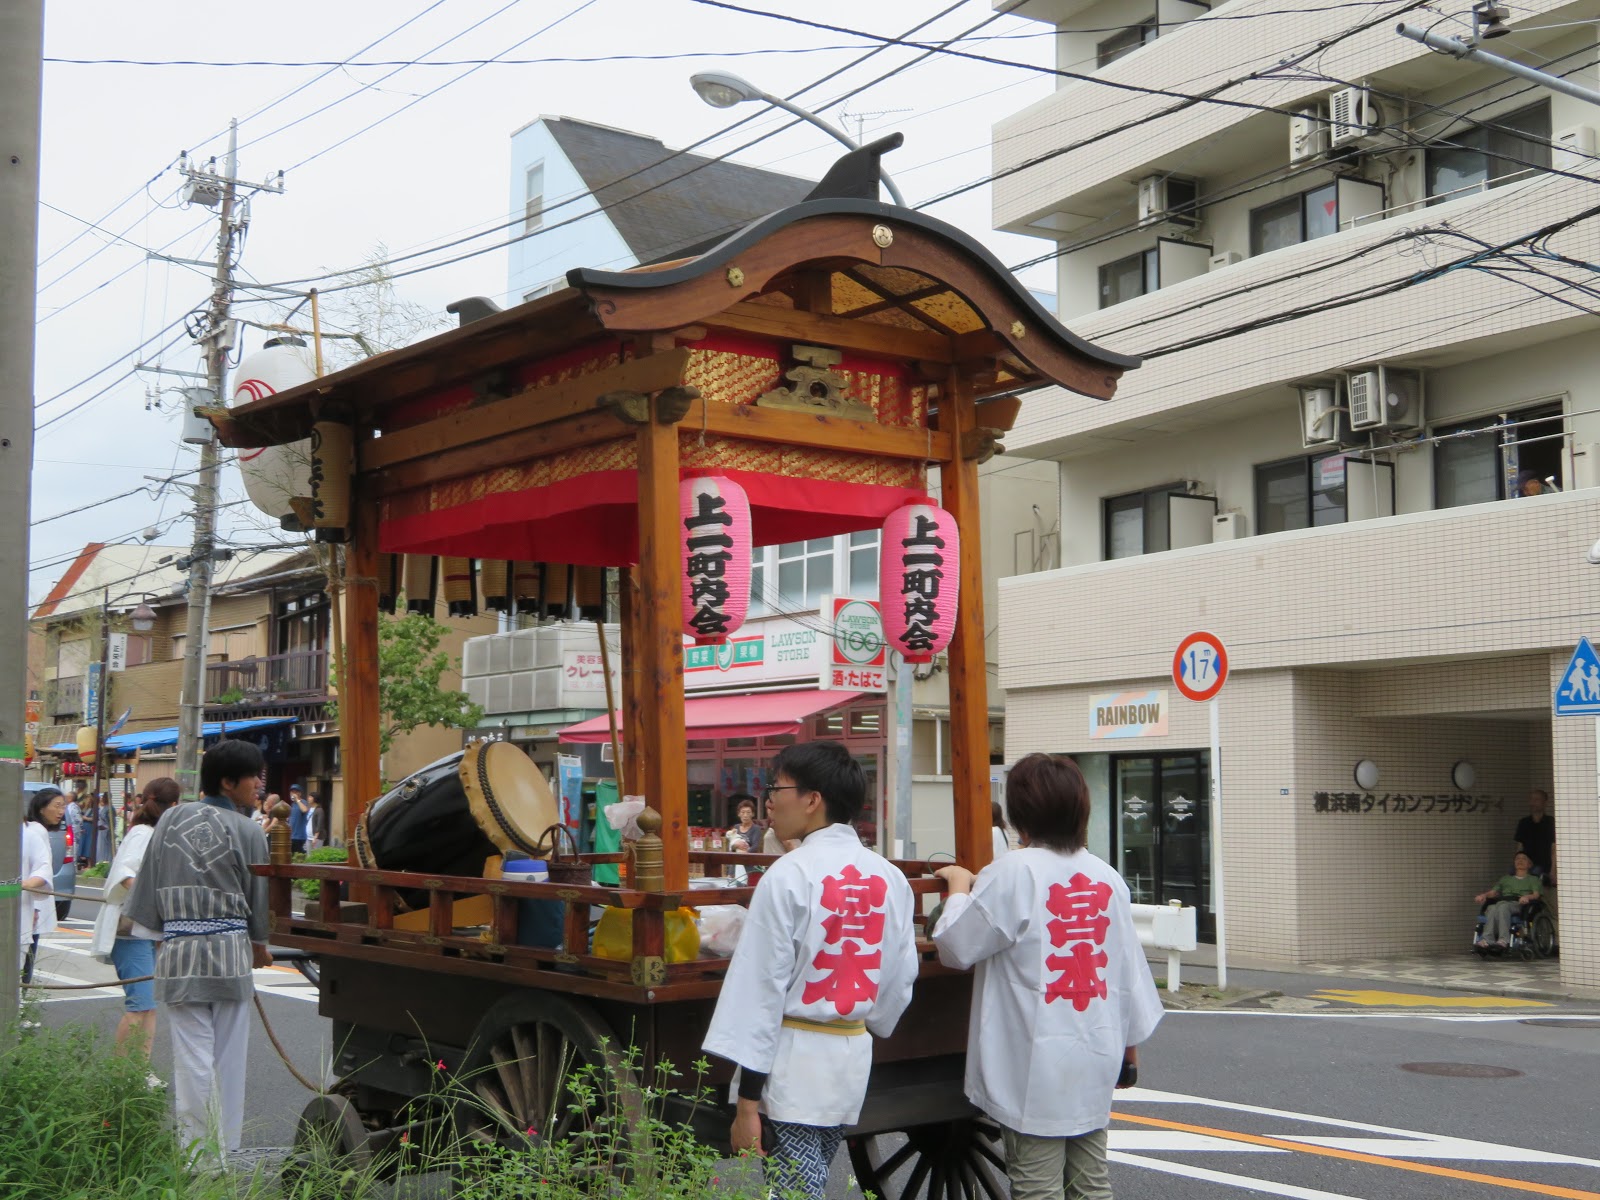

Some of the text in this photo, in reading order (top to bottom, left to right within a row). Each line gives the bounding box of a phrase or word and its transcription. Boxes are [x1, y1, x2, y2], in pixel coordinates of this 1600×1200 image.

[684, 492, 733, 635] 上一町内会
[898, 514, 945, 651] 上一町内会
[842, 614, 878, 625] LAWSON
[771, 630, 817, 648] LAWSON
[840, 629, 880, 652] 100
[777, 648, 810, 662] STORE
[1097, 703, 1160, 726] RAINBOW
[801, 863, 888, 1016] 宮本
[1044, 872, 1113, 1012] 宮本
